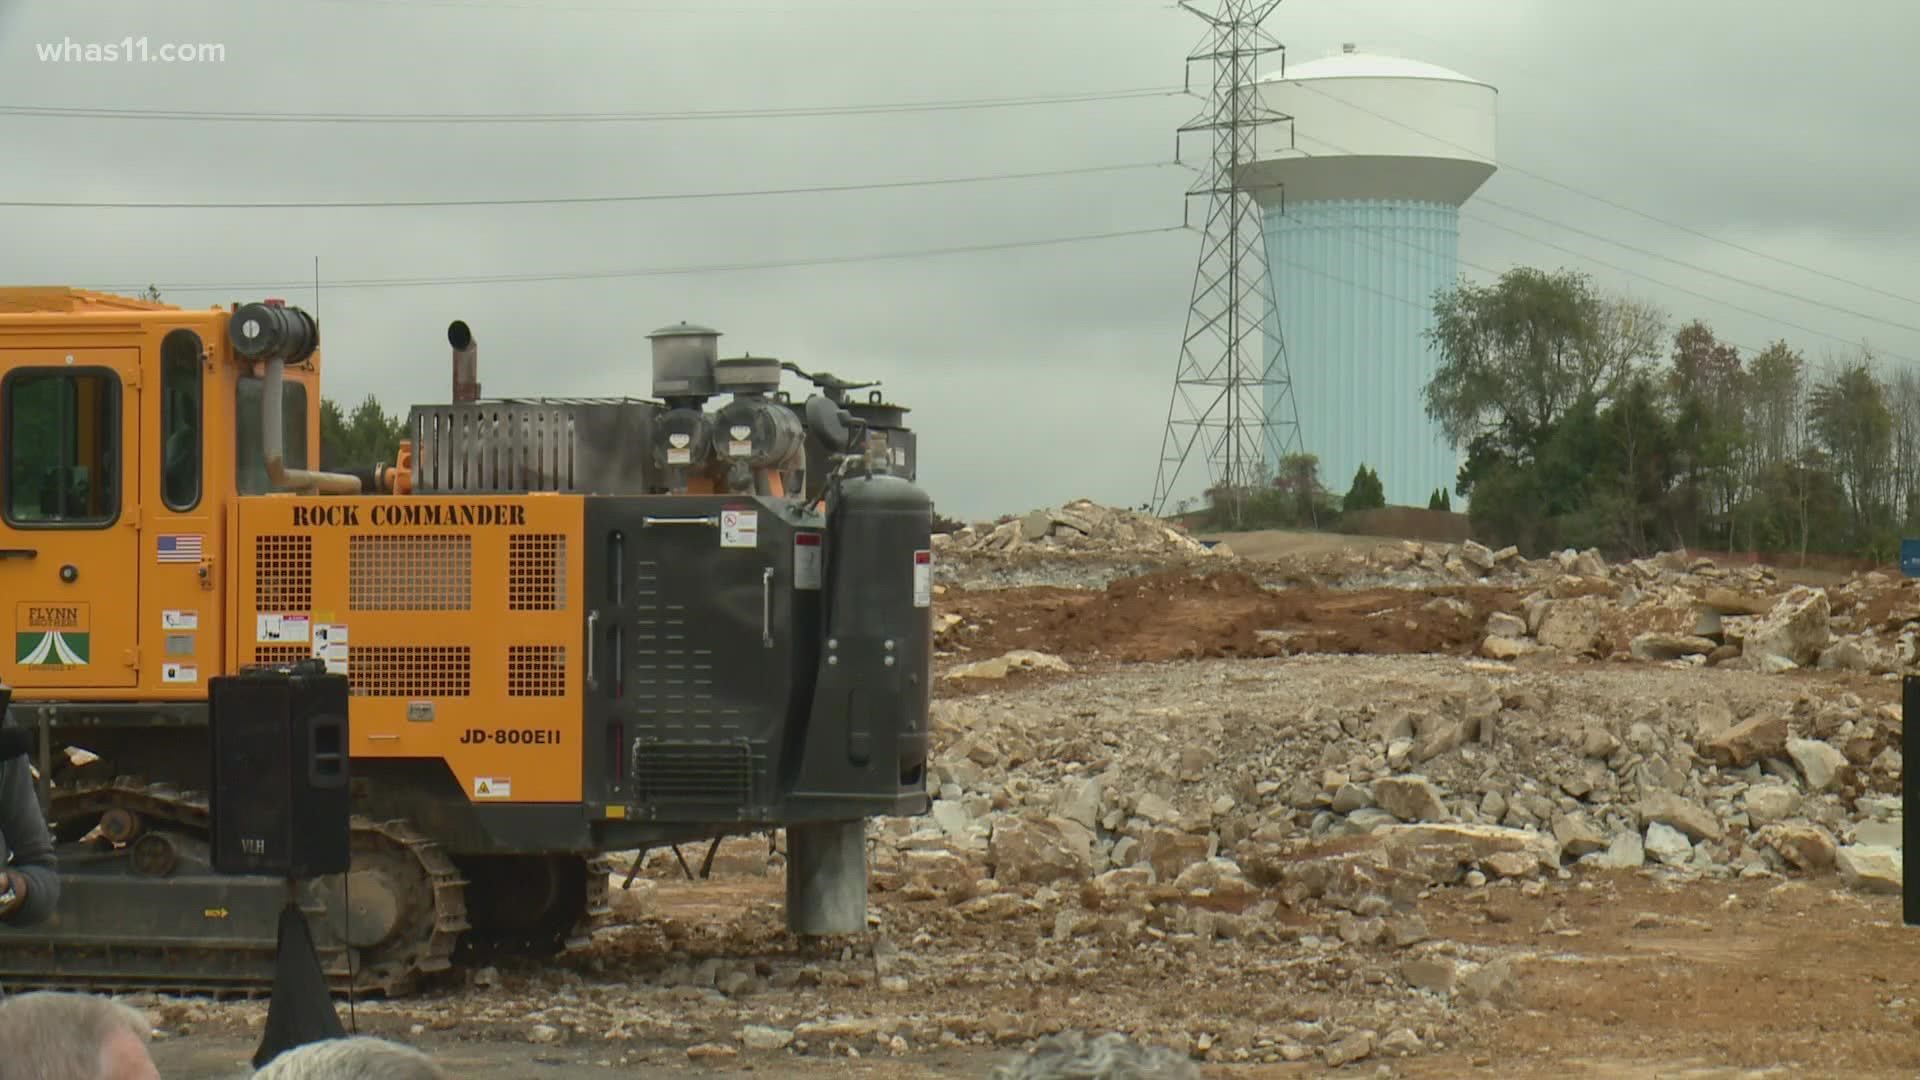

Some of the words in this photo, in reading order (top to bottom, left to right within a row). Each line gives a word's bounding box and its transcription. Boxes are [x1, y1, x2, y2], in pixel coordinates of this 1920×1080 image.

[293, 505, 359, 526] ROCK
[371, 505, 526, 526] COMMANDER
[29, 607, 78, 619] FLYNN
